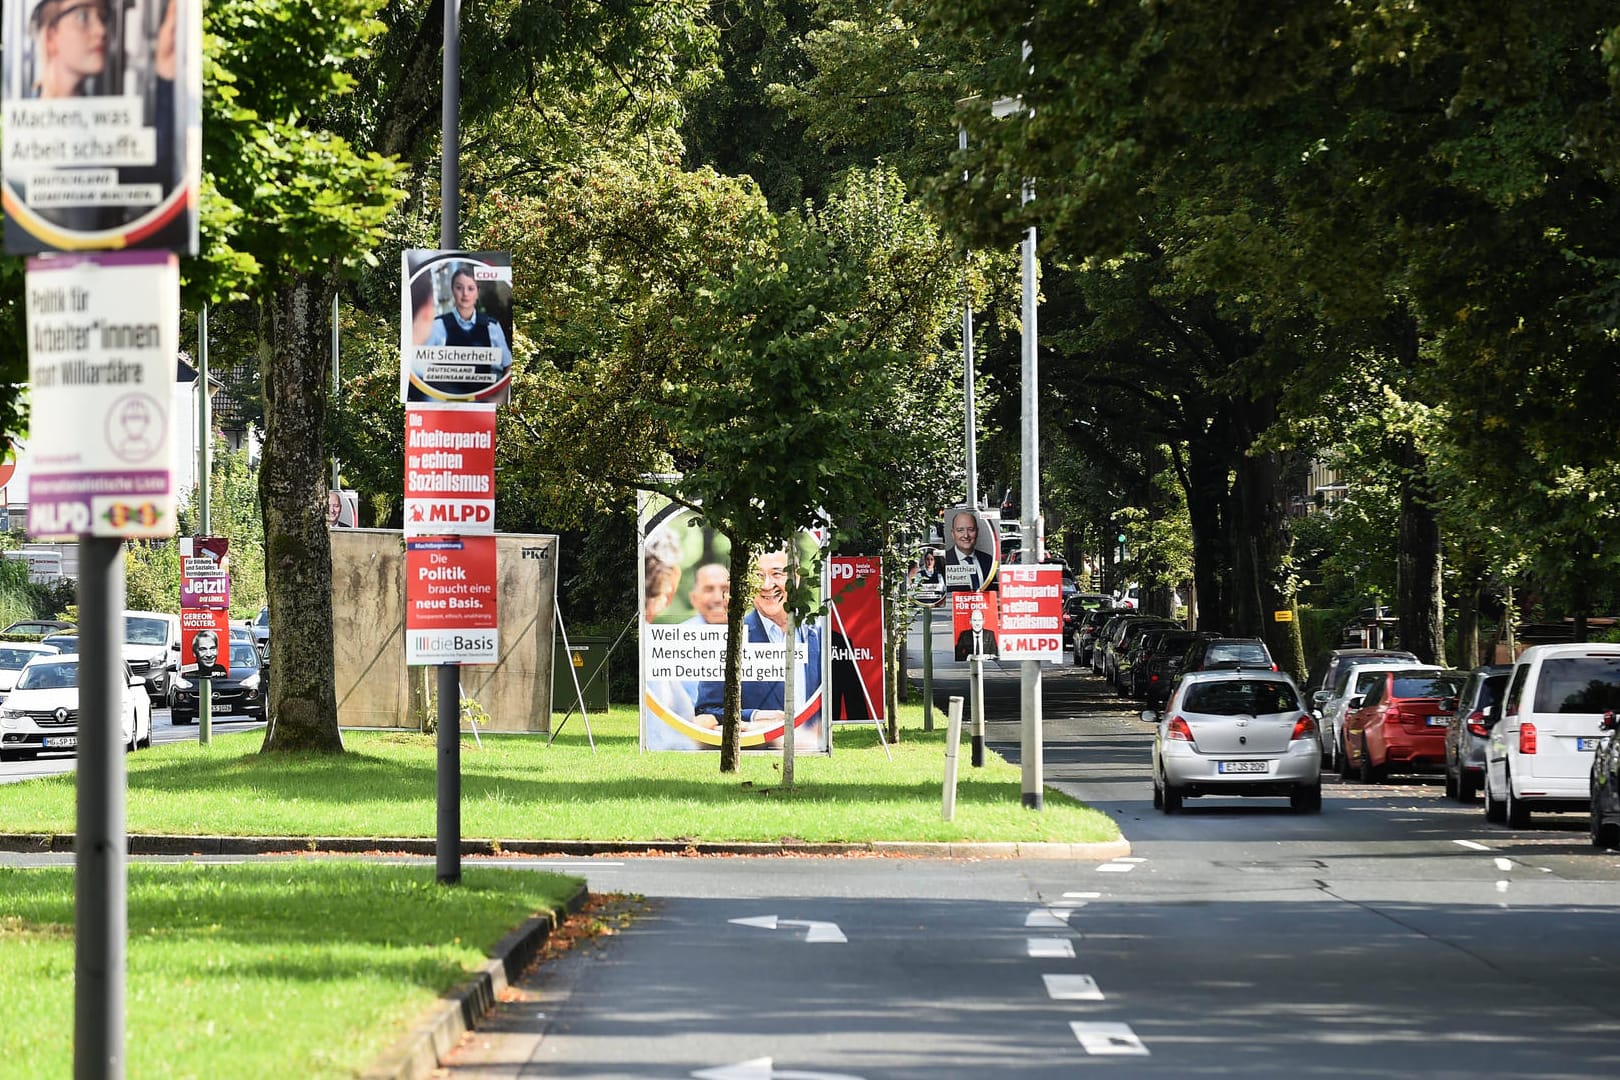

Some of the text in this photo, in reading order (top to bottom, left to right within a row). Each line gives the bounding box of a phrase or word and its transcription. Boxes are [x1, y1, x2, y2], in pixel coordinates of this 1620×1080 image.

[10, 110, 130, 128] Machen, was
[11, 135, 146, 159] Arbeit schafft.
[476, 271, 498, 280] CDU
[32, 286, 89, 312] Politik für
[416, 349, 496, 361] Mit Sicherheit.
[61, 359, 143, 384] Milliardäre
[409, 413, 422, 427] Die
[409, 429, 491, 451] Arbeiterpartei
[421, 450, 463, 469] echten
[408, 470, 490, 492] Sozialismus
[31, 501, 89, 534] MLPD
[430, 504, 490, 522] MLPD
[430, 554, 448, 564] Die
[522, 550, 549, 560] PKG
[419, 566, 467, 581] Politik
[832, 563, 854, 579] PD
[947, 565, 976, 573] Matthias
[185, 579, 227, 594] Jetzt!
[428, 584, 491, 594] braucht eine
[416, 597, 483, 609] neue Basis.
[956, 602, 970, 610] FÜR
[1002, 613, 1059, 630] Sozialismus
[652, 628, 680, 641] Weil
[684, 631, 697, 641] es
[701, 632, 720, 641] um
[1016, 638, 1059, 652] MLPD
[652, 646, 716, 660] Menschen
[720, 648, 751, 663] gt,
[831, 645, 874, 661] ÄHLEN.
[652, 668, 672, 677] um
[676, 665, 753, 678] Deutschnd
